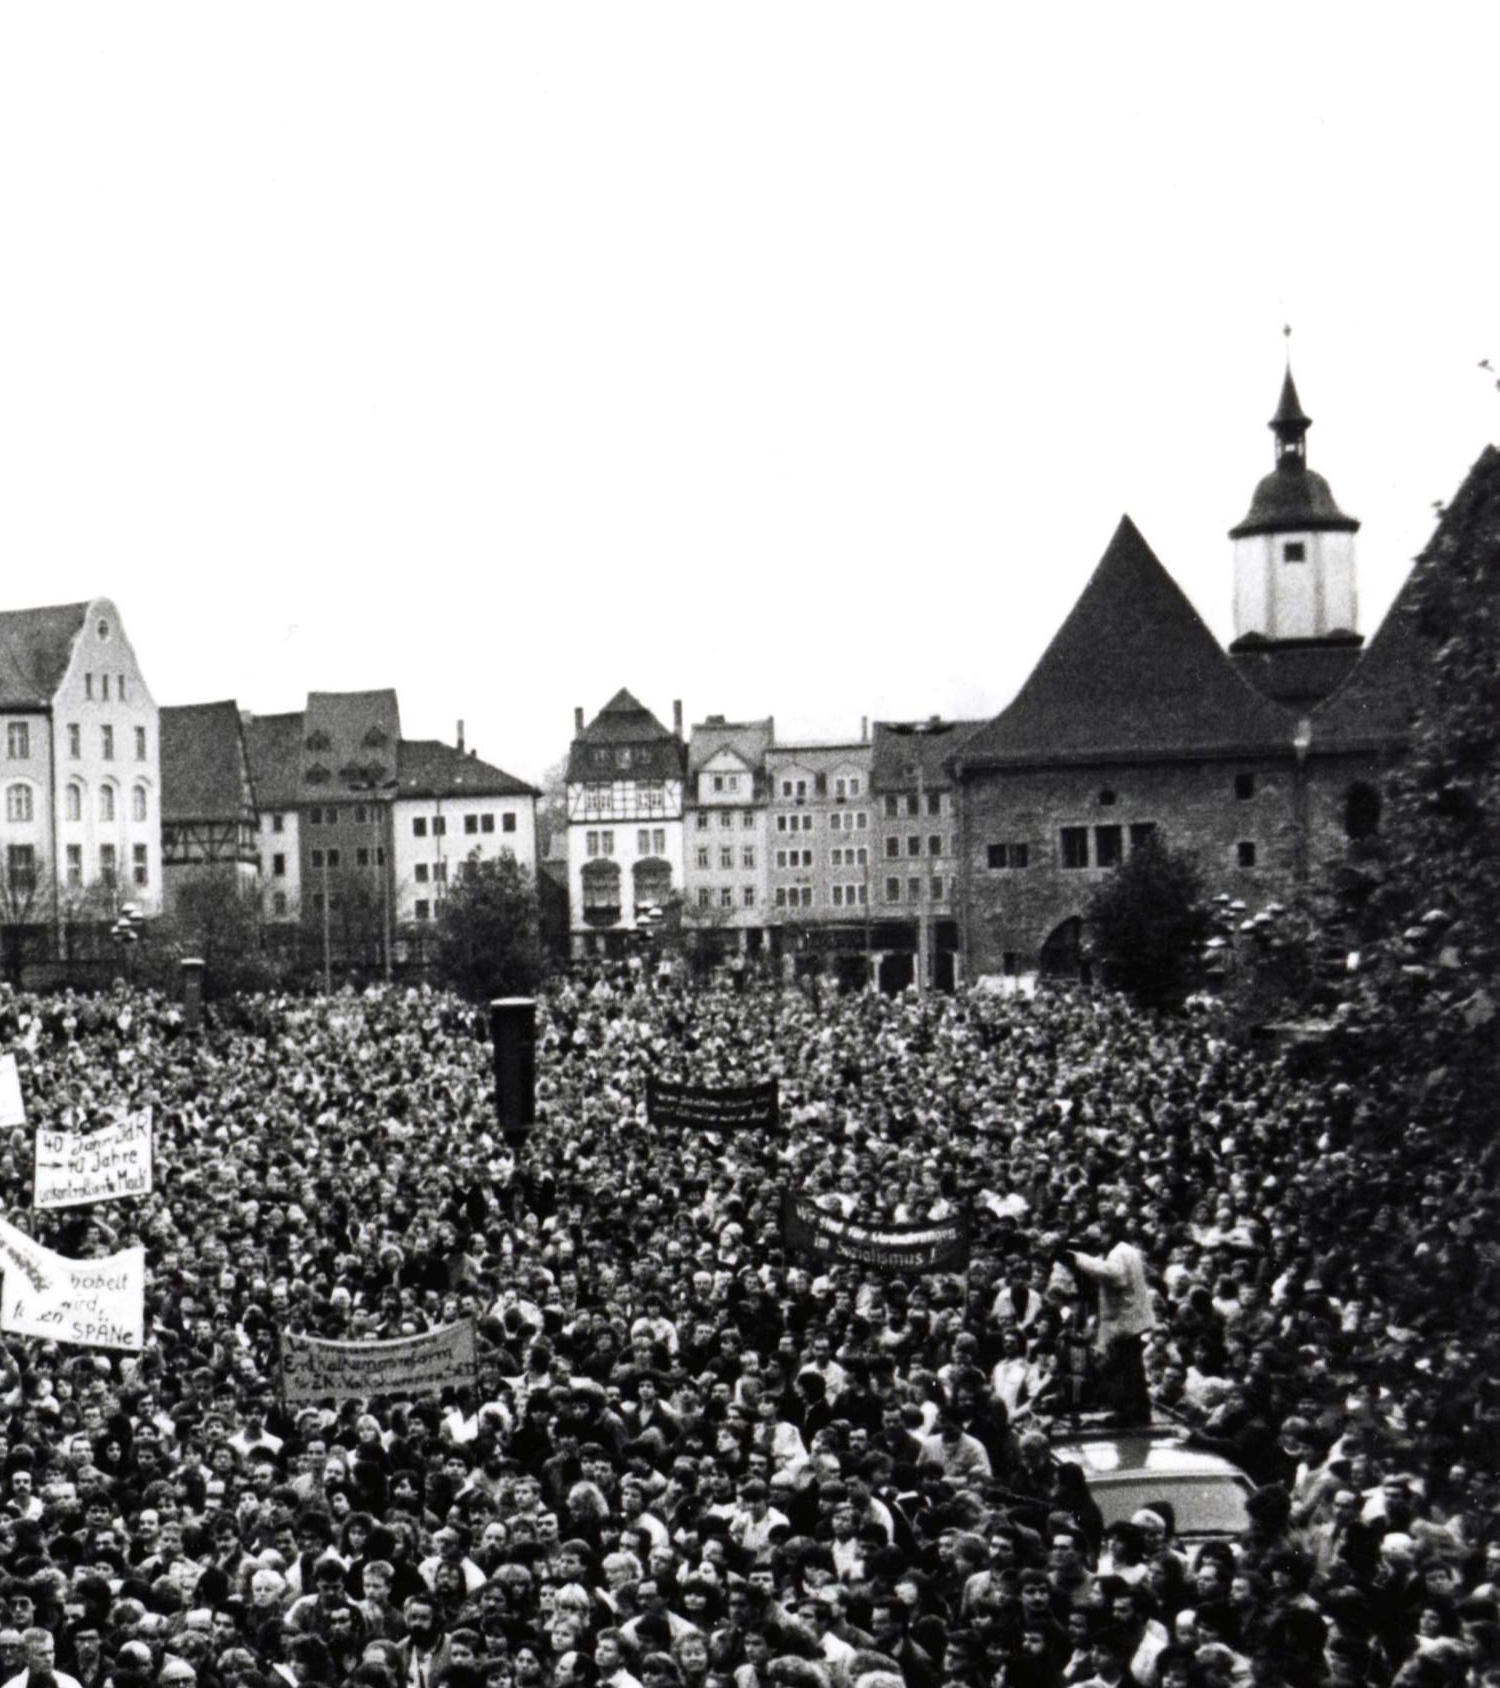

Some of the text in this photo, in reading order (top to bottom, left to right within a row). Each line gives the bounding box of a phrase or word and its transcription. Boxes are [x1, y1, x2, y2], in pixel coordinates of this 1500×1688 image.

[43, 1135, 63, 1152] 40
[91, 1150, 137, 1173] Jahre
[836, 1240, 924, 1267] Sozialismus
